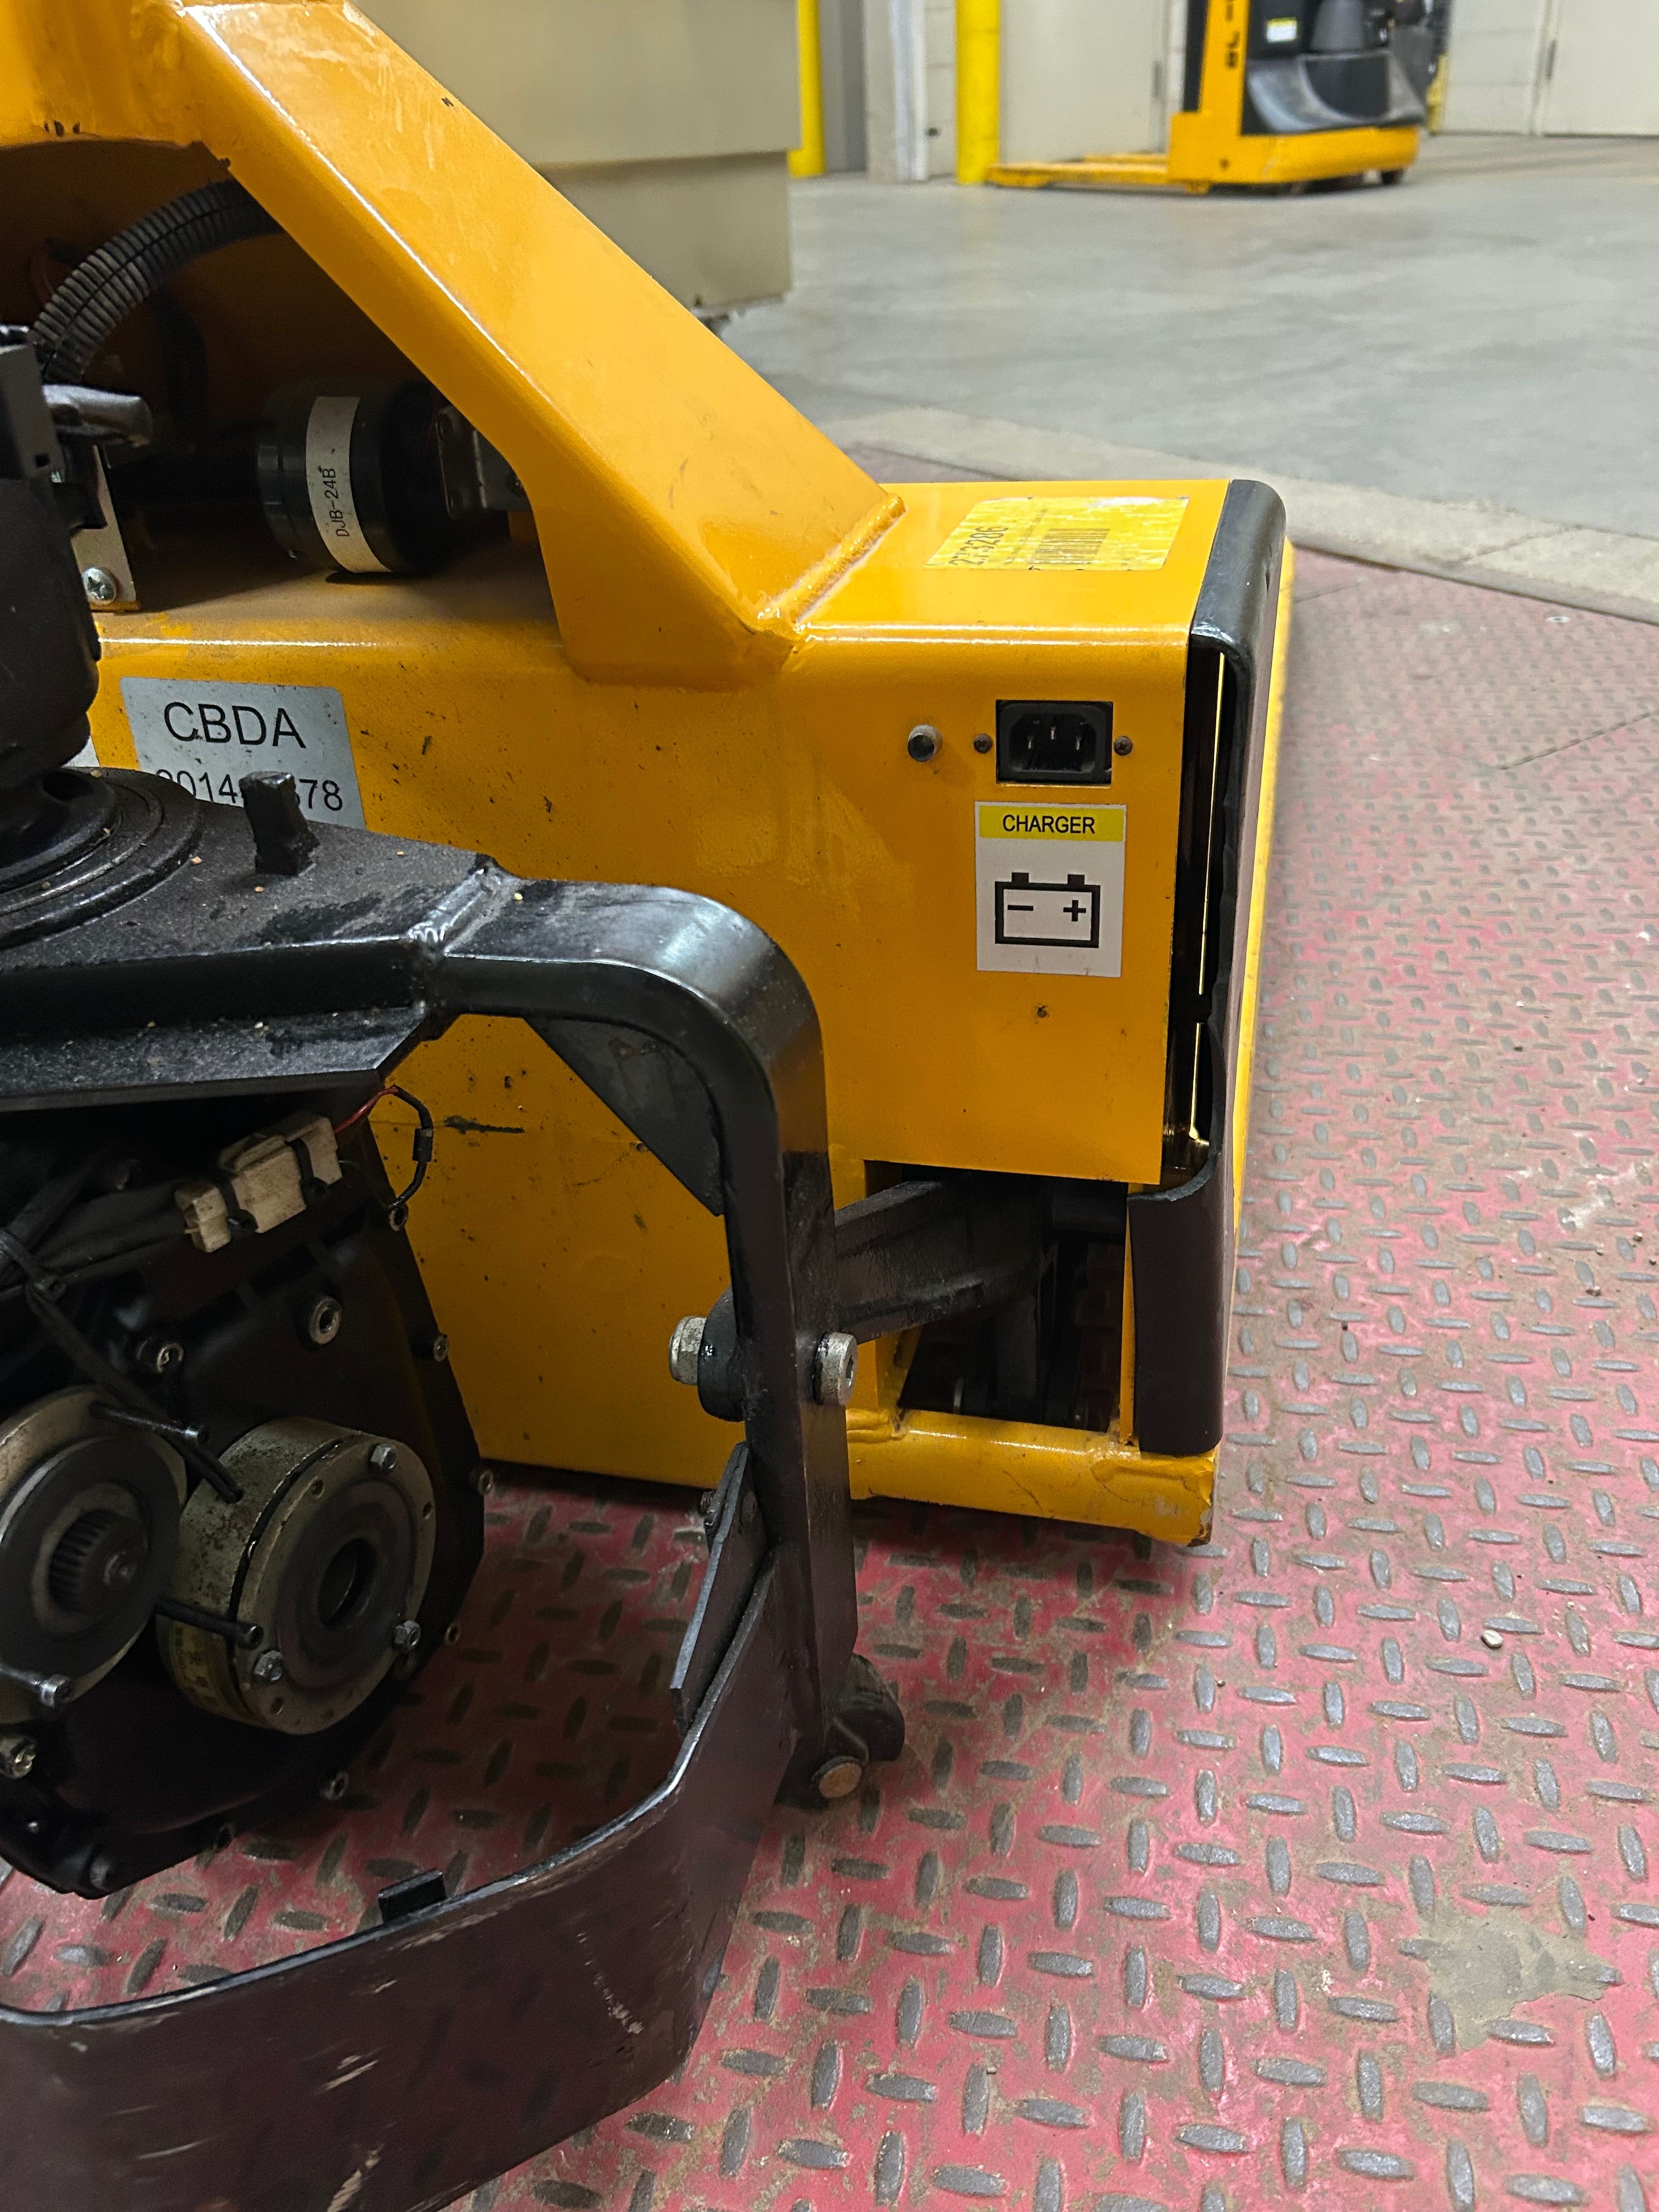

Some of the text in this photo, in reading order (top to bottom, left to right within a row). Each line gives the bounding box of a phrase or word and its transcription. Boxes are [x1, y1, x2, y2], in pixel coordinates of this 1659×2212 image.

[322, 467, 349, 537] DJB-24B
[165, 702, 306, 748] CBDA
[1002, 814, 1096, 834] CHARGER
